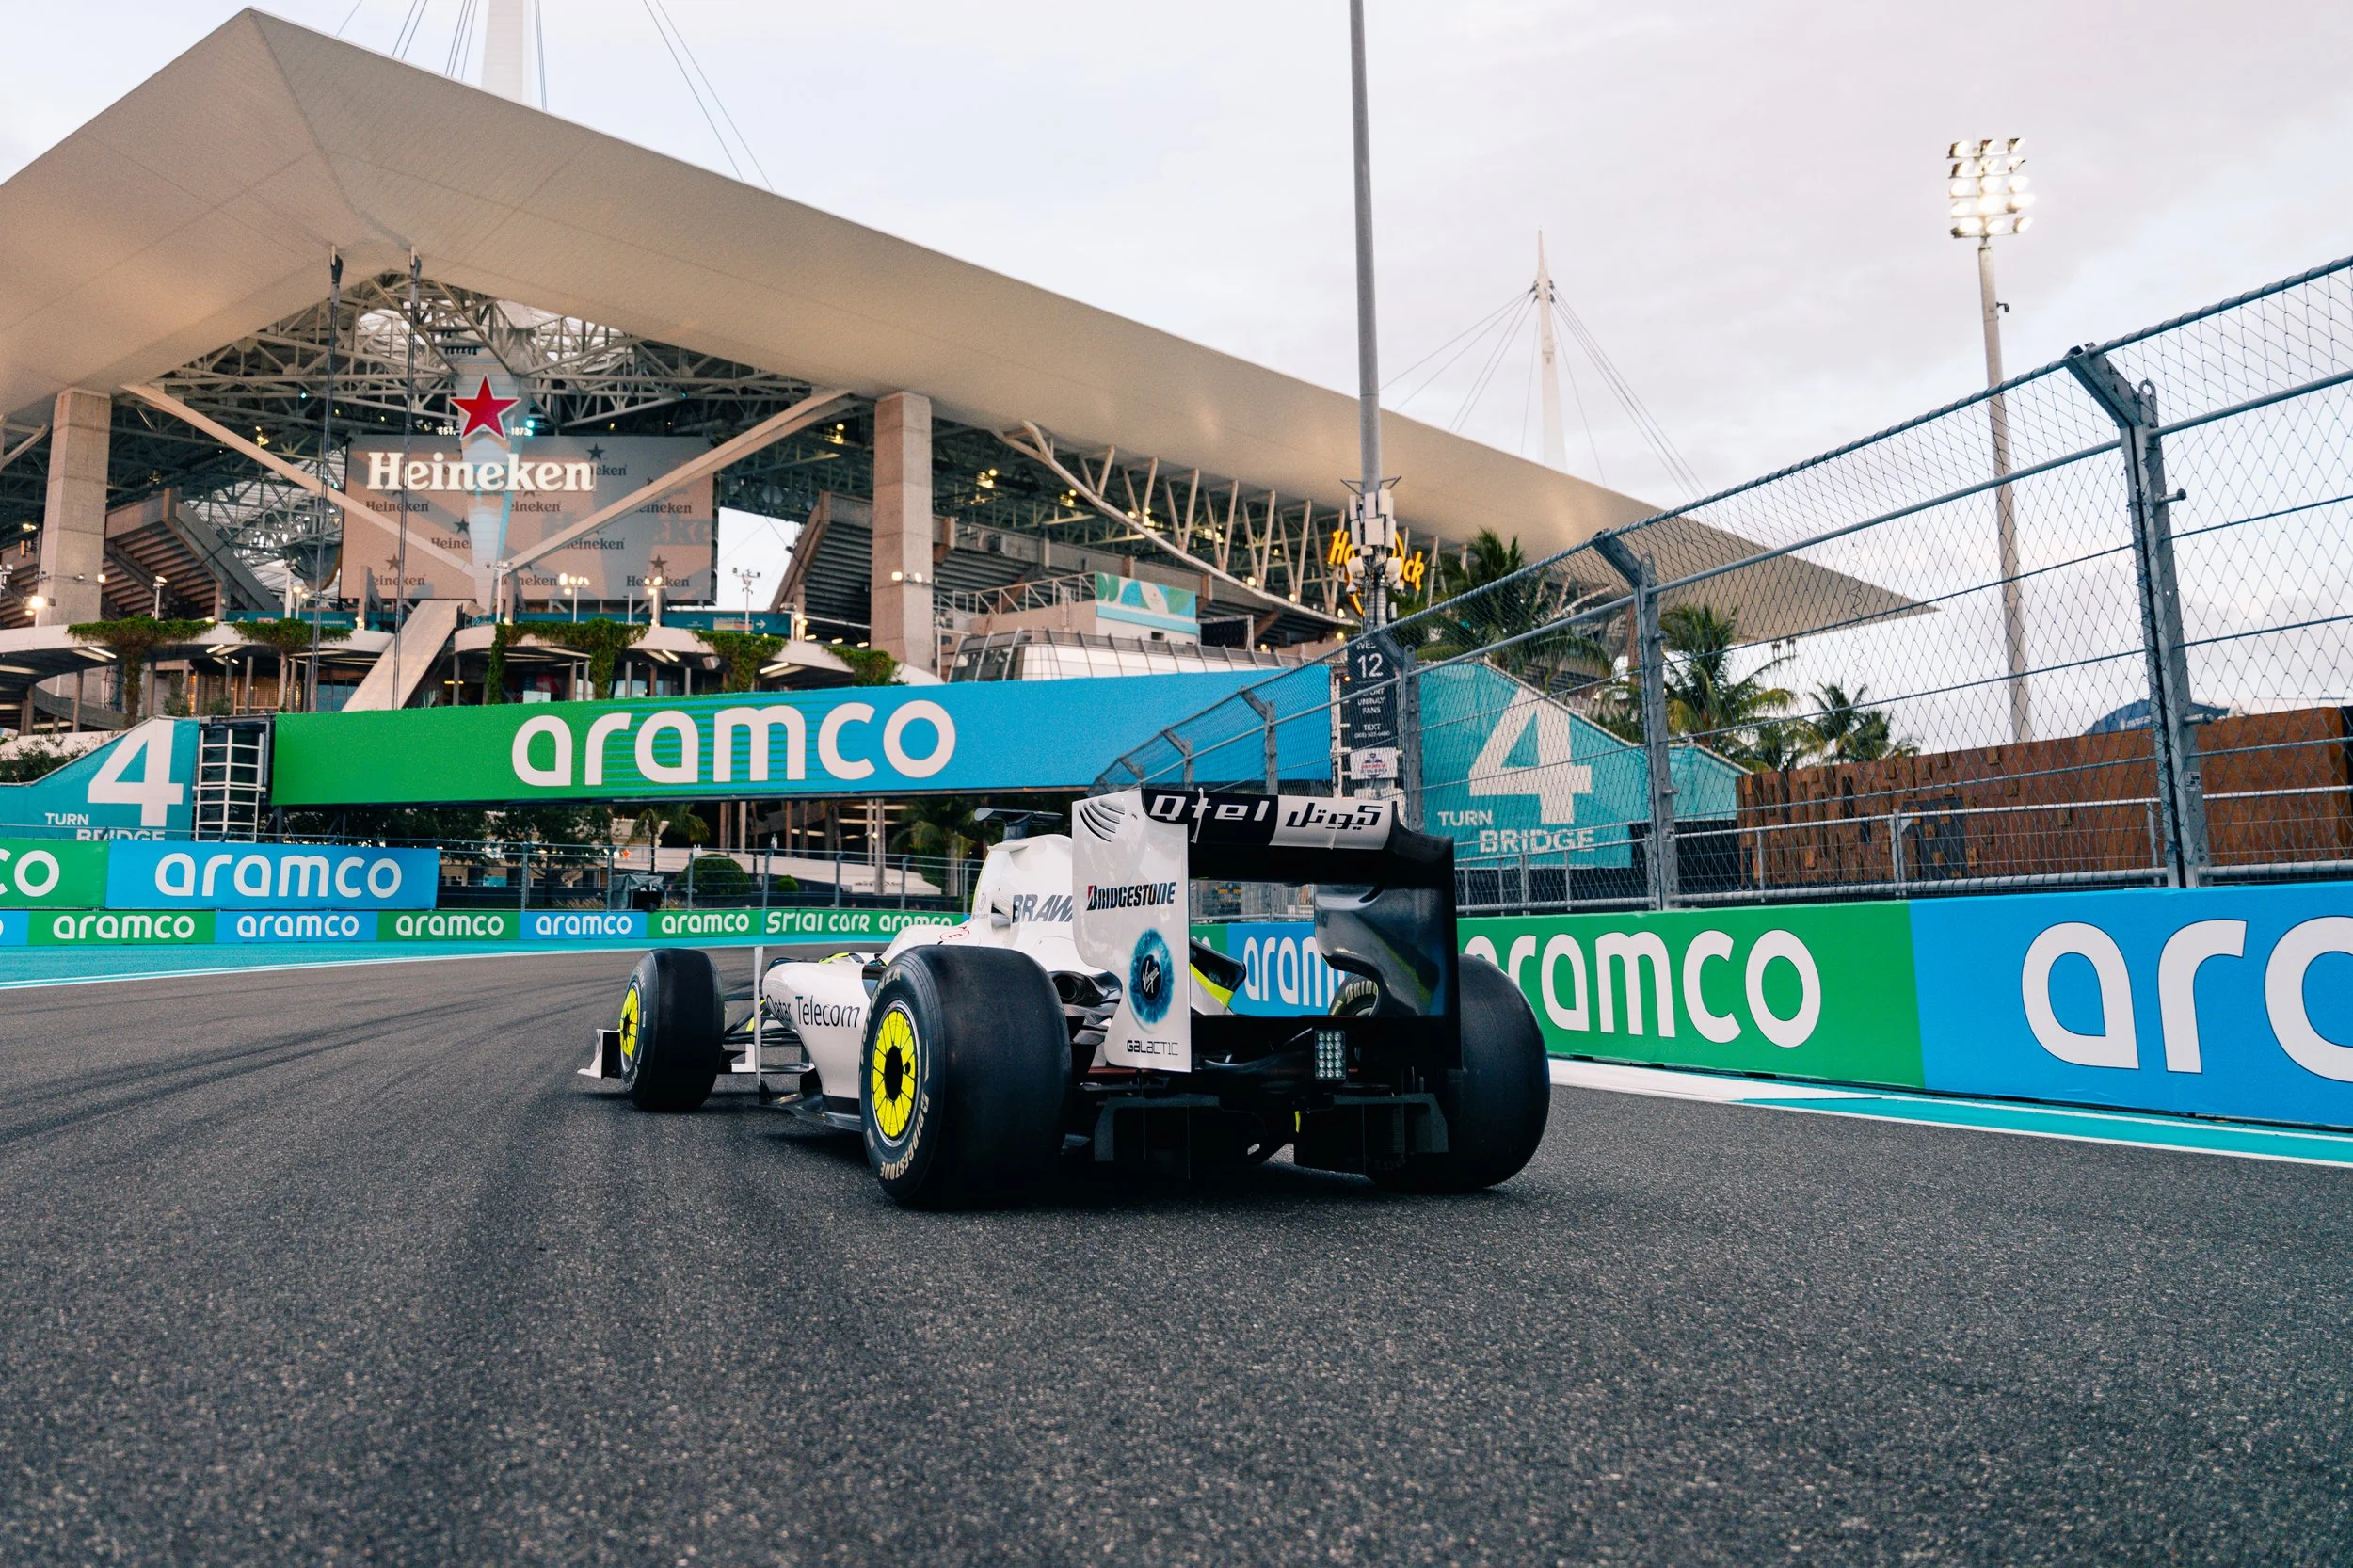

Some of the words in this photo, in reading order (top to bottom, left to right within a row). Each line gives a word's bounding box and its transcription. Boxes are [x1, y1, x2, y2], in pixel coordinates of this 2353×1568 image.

[366, 451, 595, 491] Heineken
[511, 501, 561, 512] eineken
[635, 503, 693, 514] eineken
[431, 537, 472, 550] Heine
[376, 574, 425, 586] eineken
[1357, 652, 1384, 679] 12
[511, 699, 956, 788] aramco
[1468, 686, 1593, 825] 4
[88, 719, 184, 827] 4
[45, 812, 89, 826] TURN
[1148, 794, 1270, 821] Qtel
[1437, 810, 1494, 827] TURN
[1479, 828, 1595, 855] BRIDGE
[154, 852, 403, 898] aramco
[1086, 881, 1176, 912] BRIDGESTONE
[53, 915, 196, 940] aramco
[236, 915, 360, 938] aramco
[395, 915, 504, 936] aramco
[536, 915, 632, 936] aramco
[661, 913, 749, 934] aramco
[1141, 959, 1160, 994] Virgin
[795, 994, 861, 1028] Telecom
